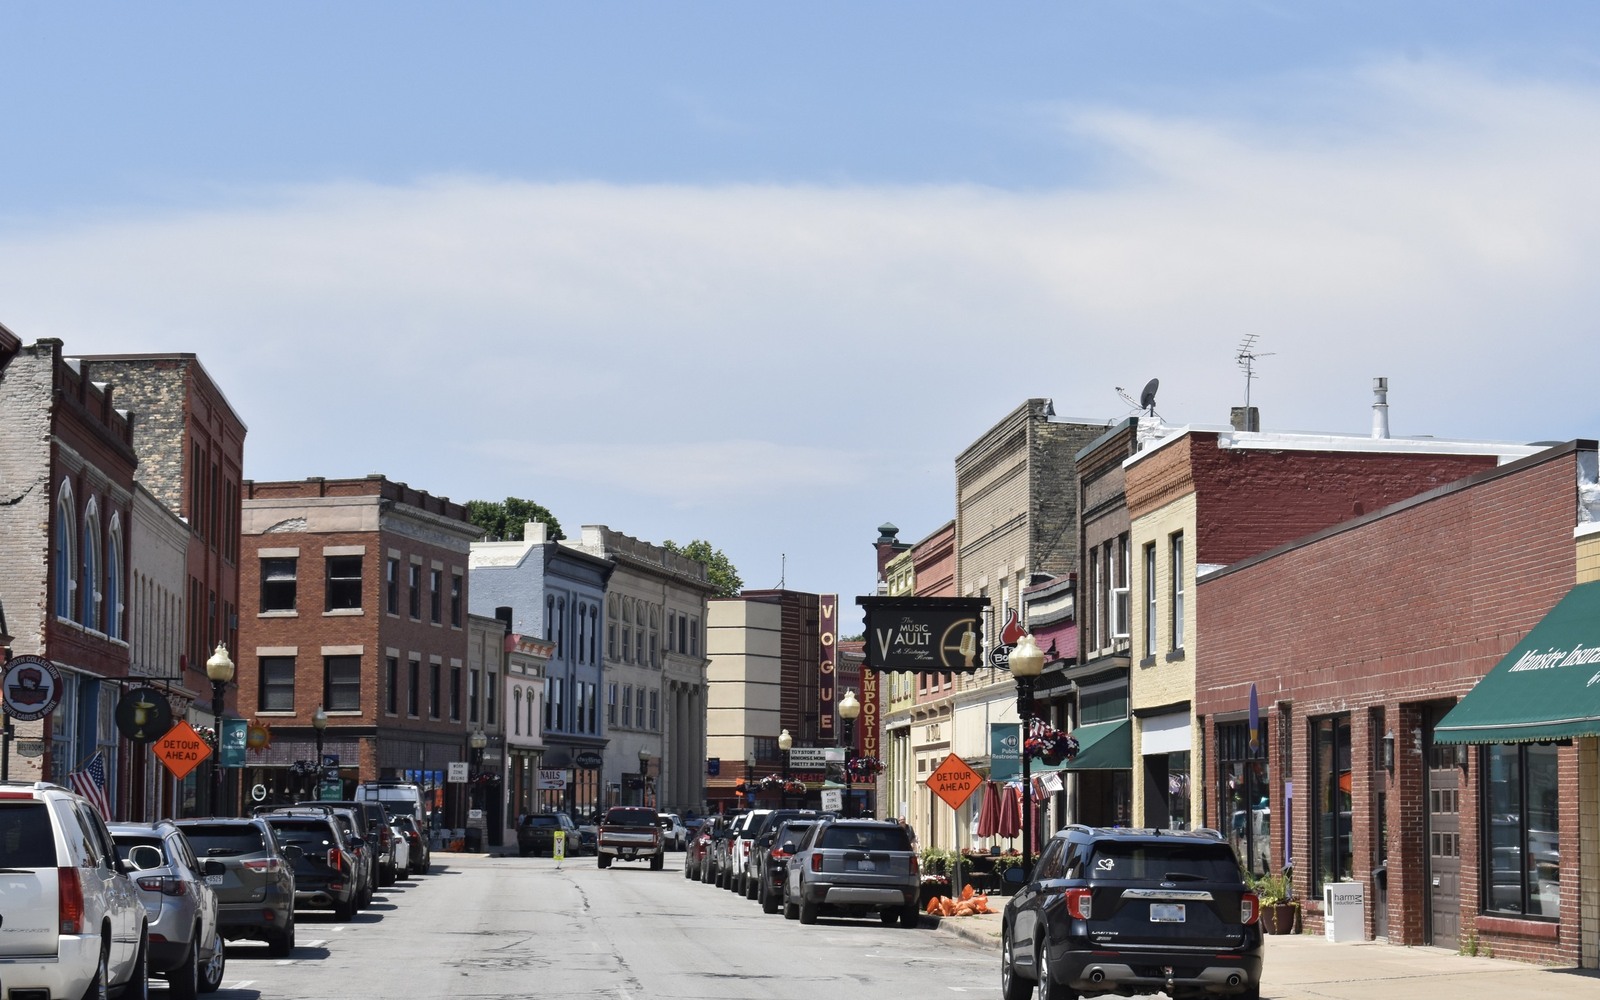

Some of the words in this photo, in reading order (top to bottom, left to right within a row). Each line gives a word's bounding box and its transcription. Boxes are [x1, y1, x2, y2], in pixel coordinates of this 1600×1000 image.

[900, 624, 929, 632] MUSIC
[1508, 646, 1567, 673] Manistee
[6, 657, 26, 670] NORTH
[26, 656, 59, 680] COLLECTORS
[821, 604, 834, 729] VOGUE
[42, 700, 57, 715] MORE
[864, 668, 876, 758] EMPORIUM
[164, 740, 199, 750] DETOUR
[165, 751, 198, 760] AHEAD
[541, 771, 560, 779] NAILS
[936, 772, 971, 781] DETOUR
[939, 782, 970, 791] AHEAD
